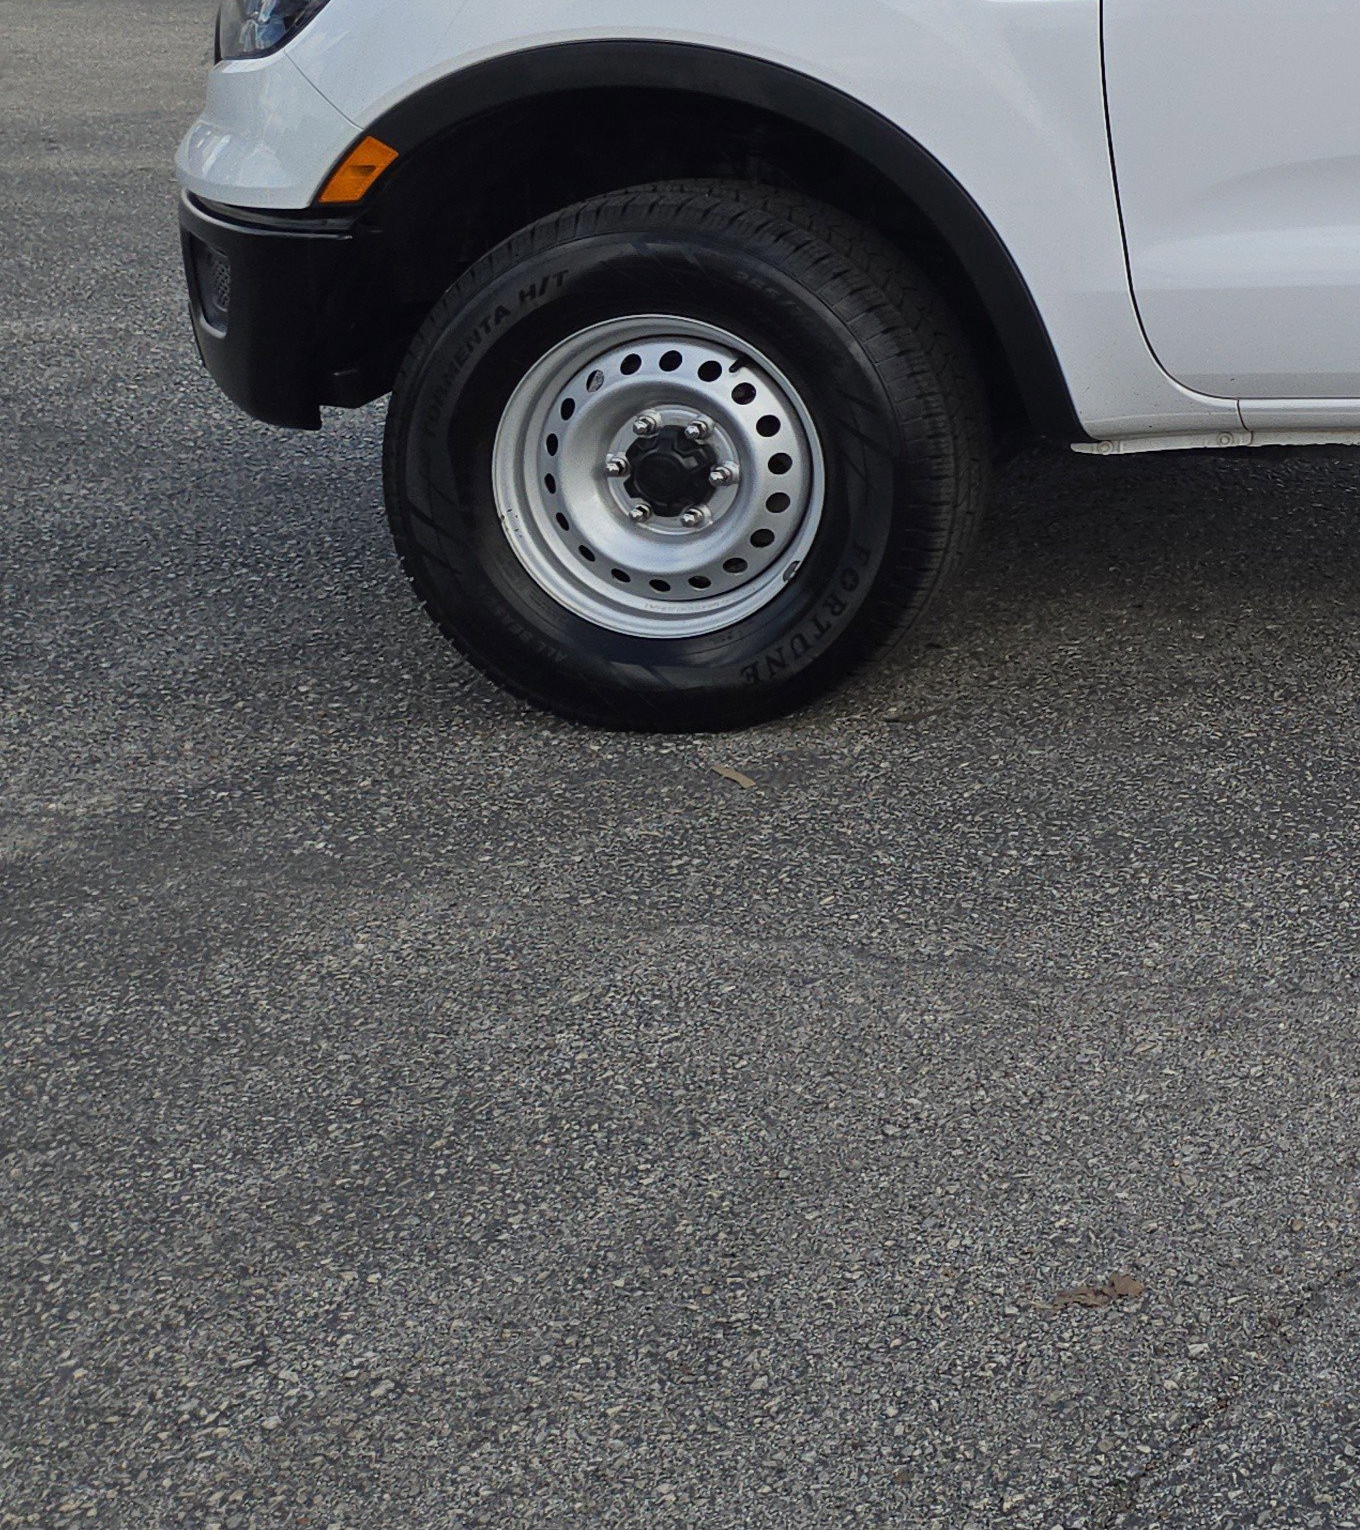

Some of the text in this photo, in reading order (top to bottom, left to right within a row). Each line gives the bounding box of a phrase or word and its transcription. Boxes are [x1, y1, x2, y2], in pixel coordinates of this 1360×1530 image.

[421, 268, 570, 438] TORMENTA H/T
[737, 541, 876, 687] FORTUNE
